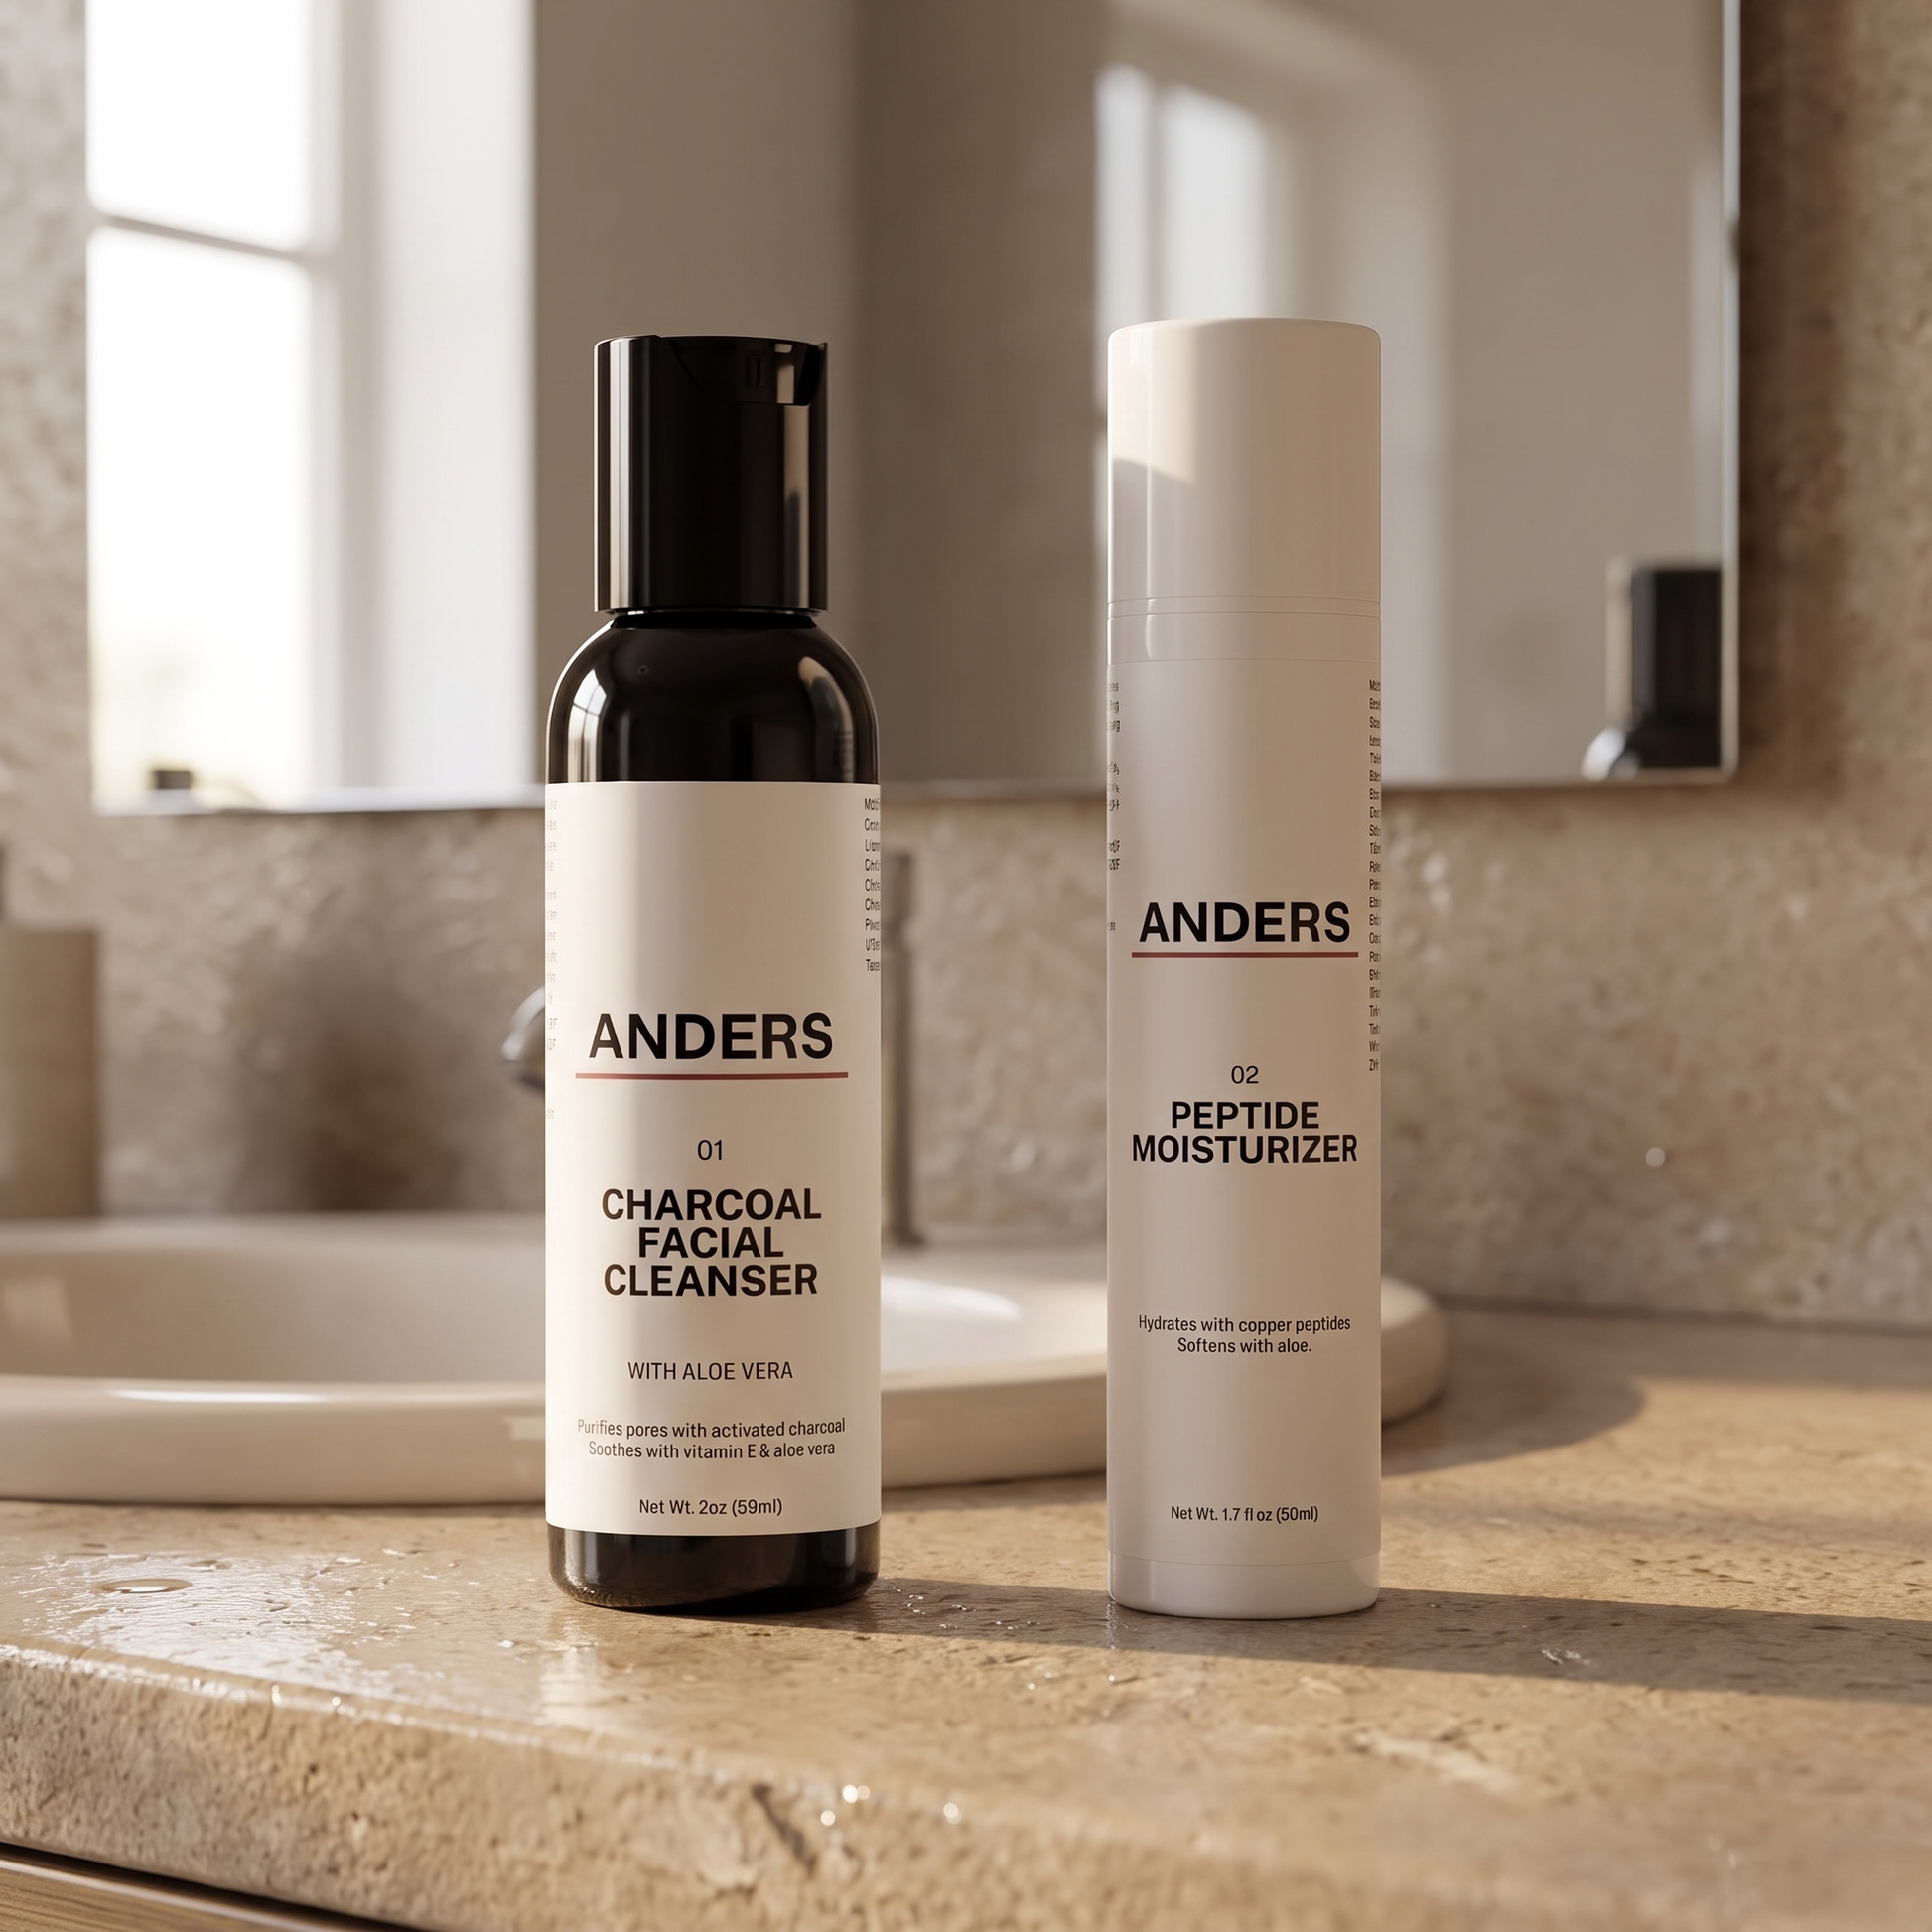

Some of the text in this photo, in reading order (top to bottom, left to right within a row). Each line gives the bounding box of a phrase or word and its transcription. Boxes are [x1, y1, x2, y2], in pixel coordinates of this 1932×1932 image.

[1139, 900, 1351, 943] ANDERS
[589, 1012, 833, 1059] ANDERS
[1231, 1065, 1259, 1085] 02
[1172, 1101, 1319, 1130] PEPTIDE
[697, 1139, 723, 1161] 01
[1132, 1134, 1357, 1164] MOISTURIZER
[602, 1187, 822, 1221] CHARCOAL
[638, 1226, 784, 1259] FACIAL
[604, 1263, 817, 1297] CLEANSER
[1139, 1314, 1351, 1336] Hydrates with copper peptides
[1177, 1337, 1312, 1353] Softens with aloe.
[627, 1361, 793, 1381] WITH ALOE VERA
[578, 1417, 846, 1440] Purifies pores with activated charcoal
[589, 1441, 836, 1459] Soothes with vitamin E & aloe vera
[639, 1498, 783, 1518] Net Wt. 2oz (59ml)
[1171, 1506, 1319, 1525] Net Wt. 1.7 fl oz (50ml)
